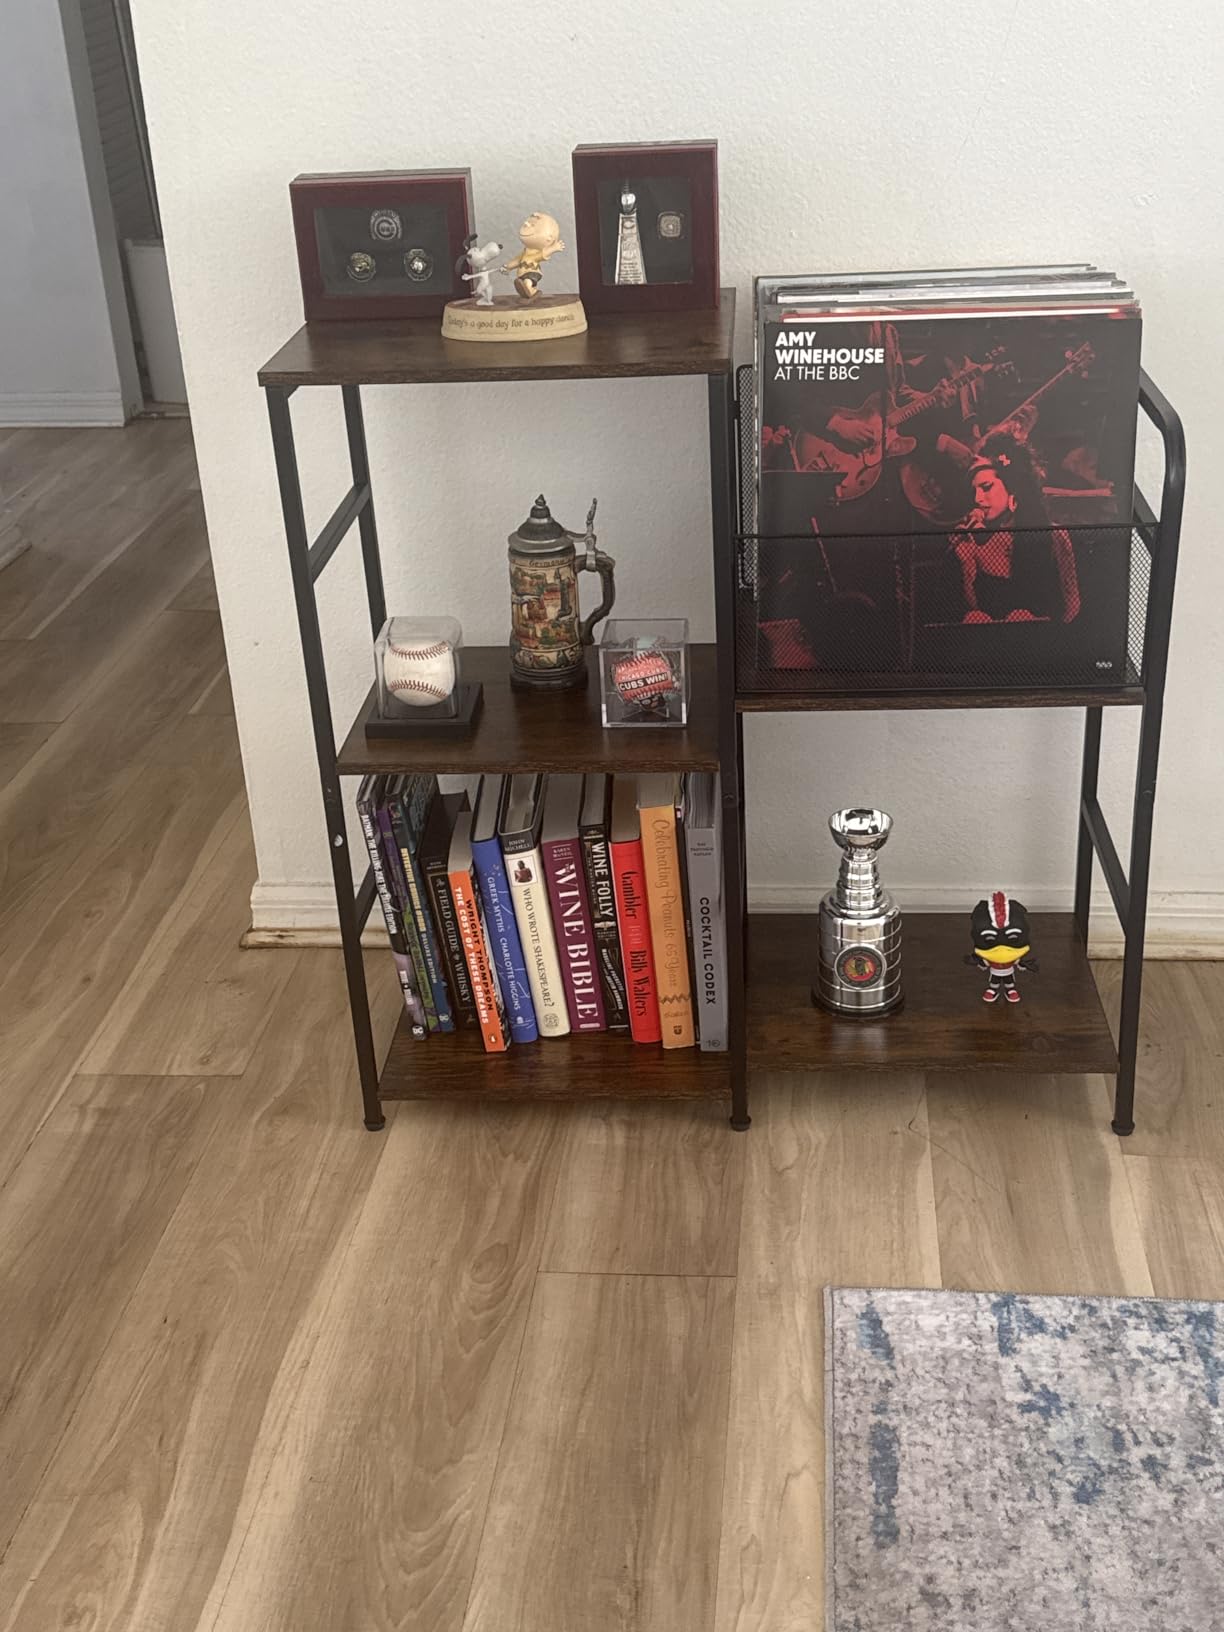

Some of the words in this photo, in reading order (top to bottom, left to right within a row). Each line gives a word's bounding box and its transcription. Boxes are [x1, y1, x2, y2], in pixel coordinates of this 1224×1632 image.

[495, 318, 510, 330] day
[511, 318, 522, 328] for
[531, 316, 555, 328] happy
[774, 331, 817, 347] AMY
[774, 347, 886, 364] WINEHOUSE
[773, 366, 793, 381] AT
[796, 366, 825, 381] THE
[829, 365, 861, 381] BBC
[619, 679, 645, 691] CUBS
[591, 841, 609, 877] WINE
[652, 819, 671, 889] Celebrating
[454, 887, 465, 907] THE
[487, 876, 500, 904] GREEK
[522, 887, 534, 912] WHO
[554, 862, 587, 937] WINE
[596, 880, 615, 917] FOLLY
[621, 870, 642, 919] Gambler
[385, 913, 398, 934] EDITION
[459, 909, 471, 935] COST
[493, 905, 505, 933] MYTHS
[526, 911, 541, 945] WROTE
[660, 890, 678, 938] Peanuts
[699, 897, 713, 960] COCKTAIL
[421, 932, 432, 957] DELUXE
[427, 958, 438, 984] EDITION
[437, 889, 451, 919] FIELD
[444, 920, 460, 952] GUIDE
[454, 963, 472, 1003] WHISKY
[464, 937, 474, 950] OF
[465, 899, 480, 946] WRIGHT
[476, 949, 494, 1011] THOMPSON
[499, 937, 516, 981] CHARLOTTE
[665, 943, 677, 957] 65
[469, 952, 481, 983] THESE
[534, 944, 556, 1008] SHAKESPEARE?
[629, 949, 648, 974] Billy
[510, 980, 521, 1011] HIGGINS
[567, 942, 599, 1019] BIBLE
[633, 976, 651, 1017] Walters
[703, 962, 717, 1005] CODEX
[475, 985, 489, 1025] DREAMS
